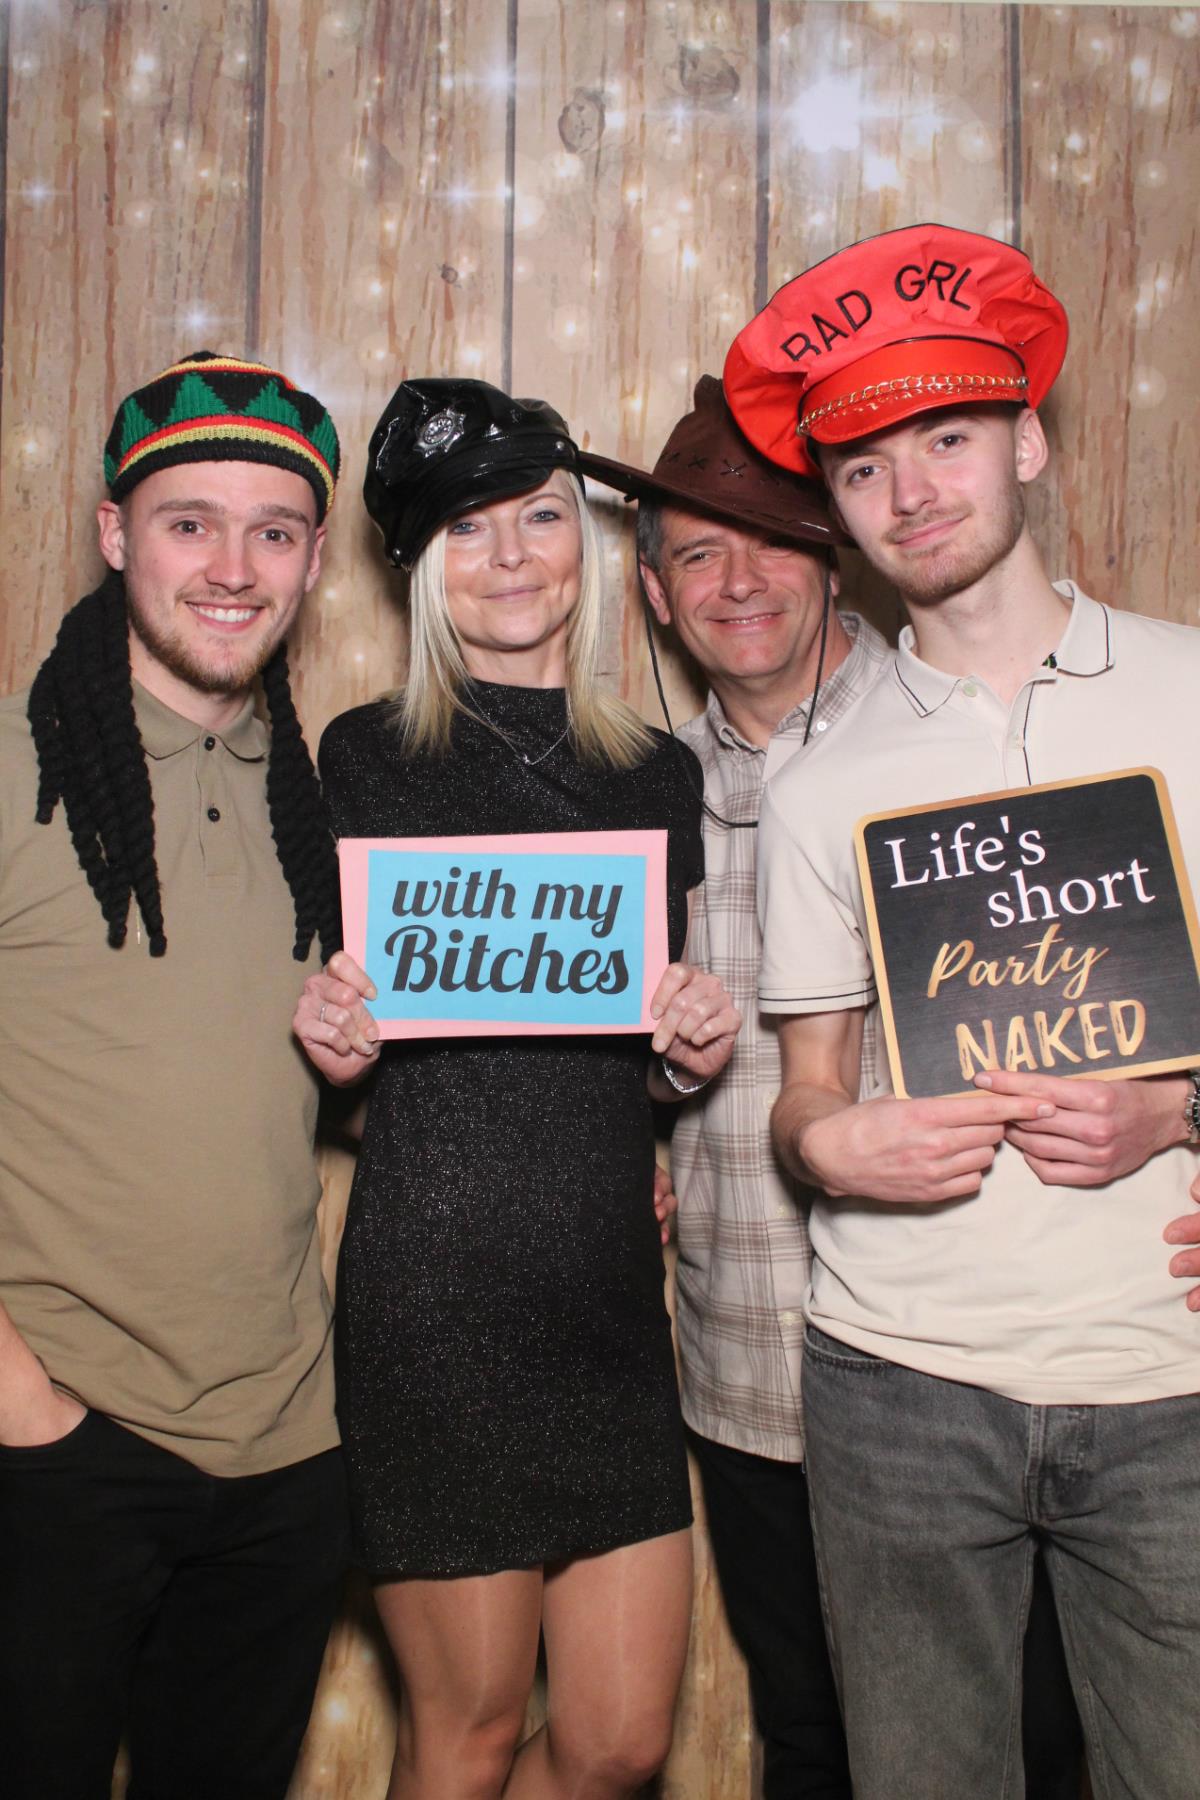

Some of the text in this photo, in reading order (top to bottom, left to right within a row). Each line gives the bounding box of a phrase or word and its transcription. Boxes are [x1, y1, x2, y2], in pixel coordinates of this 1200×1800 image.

[895, 259, 972, 311] GRL
[884, 815, 1046, 889] Life's
[391, 866, 624, 939] with my
[987, 858, 1156, 928] short
[384, 924, 630, 995] Bitches
[927, 923, 1109, 1000] Party
[955, 999, 1146, 1081] NAKED
